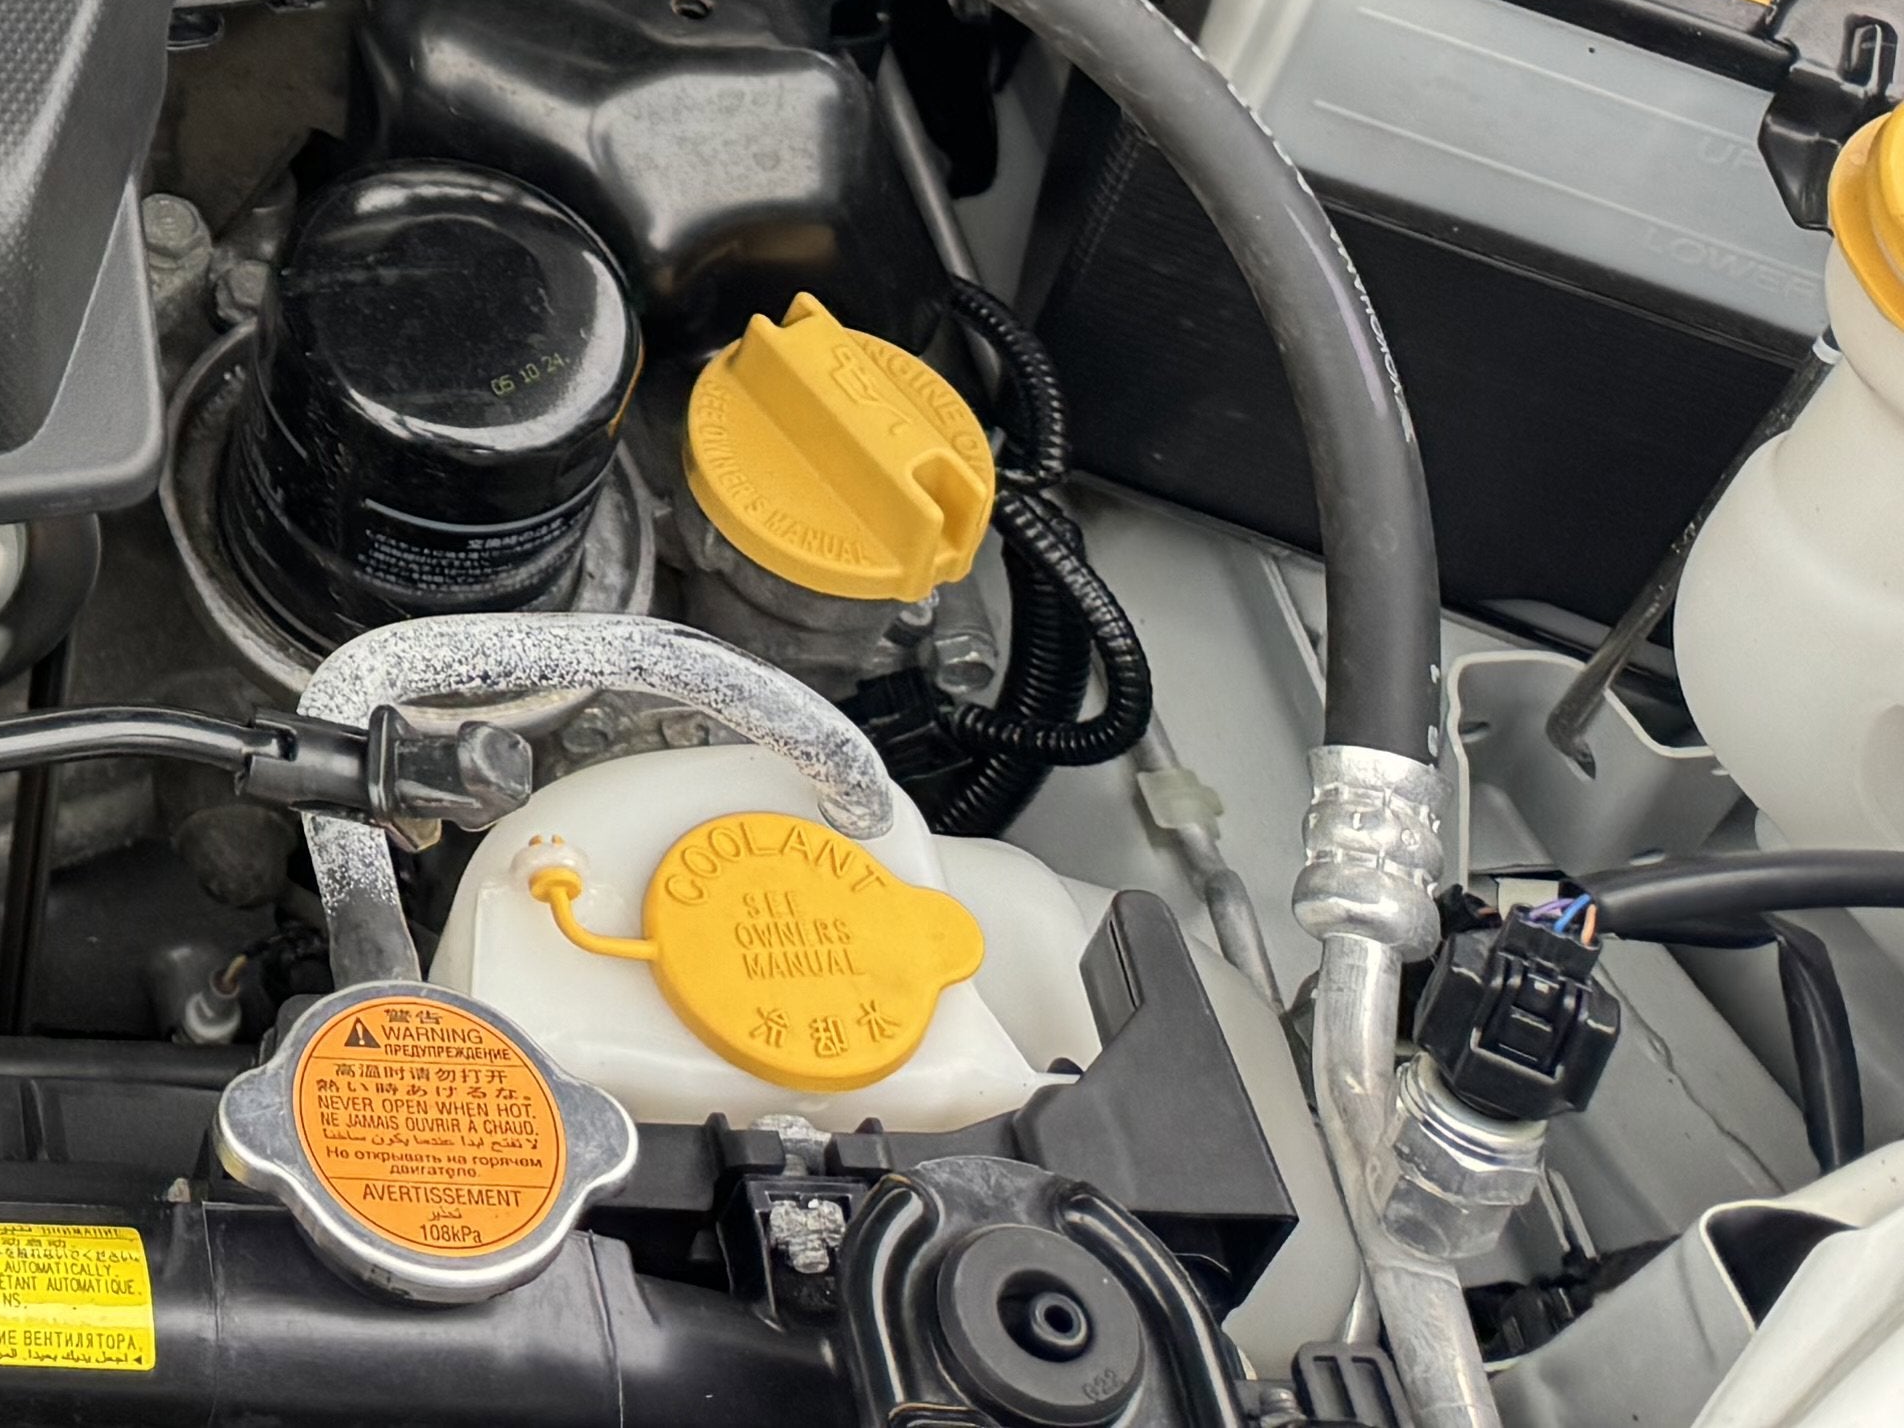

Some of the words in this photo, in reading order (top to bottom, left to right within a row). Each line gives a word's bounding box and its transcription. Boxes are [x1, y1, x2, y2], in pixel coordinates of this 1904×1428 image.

[520, 363, 540, 384] 10
[664, 821, 887, 907] COOLANT
[742, 891, 801, 920] SEE
[734, 918, 851, 950] OWNERS
[741, 948, 866, 981] MANUAL
[381, 1025, 483, 1044] WARNING
[384, 1045, 512, 1061] ПРЕДУПРЕЖДЕНИЕ
[318, 1095, 374, 1113] NEVER
[382, 1098, 428, 1115] OPEN
[435, 1100, 489, 1118] WHEN
[497, 1103, 536, 1119] HOT.
[321, 1113, 340, 1127] NE
[346, 1114, 399, 1132] JAMAIS
[405, 1116, 461, 1133] OUVRIR
[484, 1119, 539, 1136] CHAUD.
[362, 1183, 522, 1208] AVERTISSEMENT
[420, 1224, 482, 1243] 108kPa
[4, 1260, 120, 1277] AUTOMATICALLY.
[47, 1277, 142, 1295] AUTOMATIQUE.
[24, 1330, 143, 1352] ВЕНТИЛЯТОРА.
